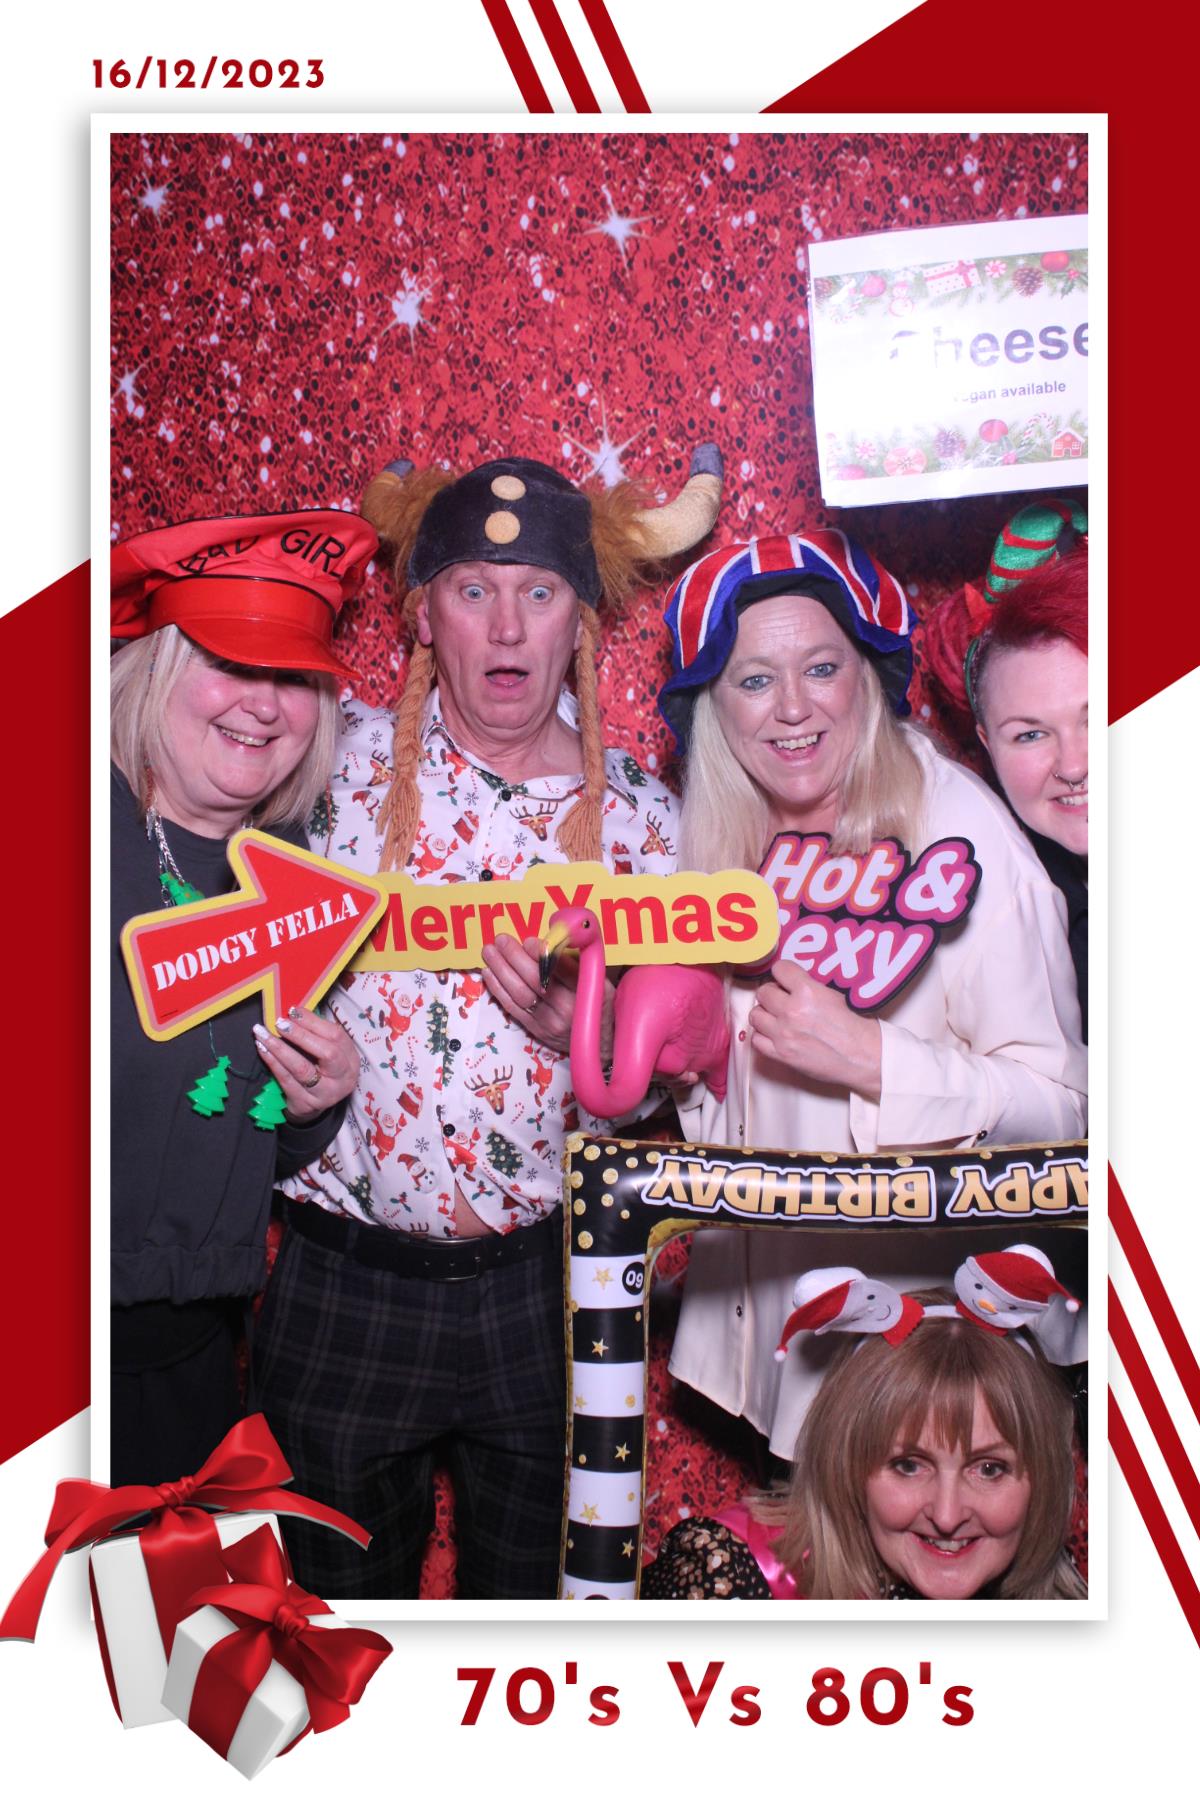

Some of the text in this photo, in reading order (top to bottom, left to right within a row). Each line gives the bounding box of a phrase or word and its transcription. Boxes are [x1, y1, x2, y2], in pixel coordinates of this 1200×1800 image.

[1001, 380, 1067, 398] available
[764, 843, 966, 914] Hot &
[152, 893, 360, 991] DODGY FELLA
[778, 908, 924, 999] exy
[646, 1158, 932, 1219] BIRTHDAY
